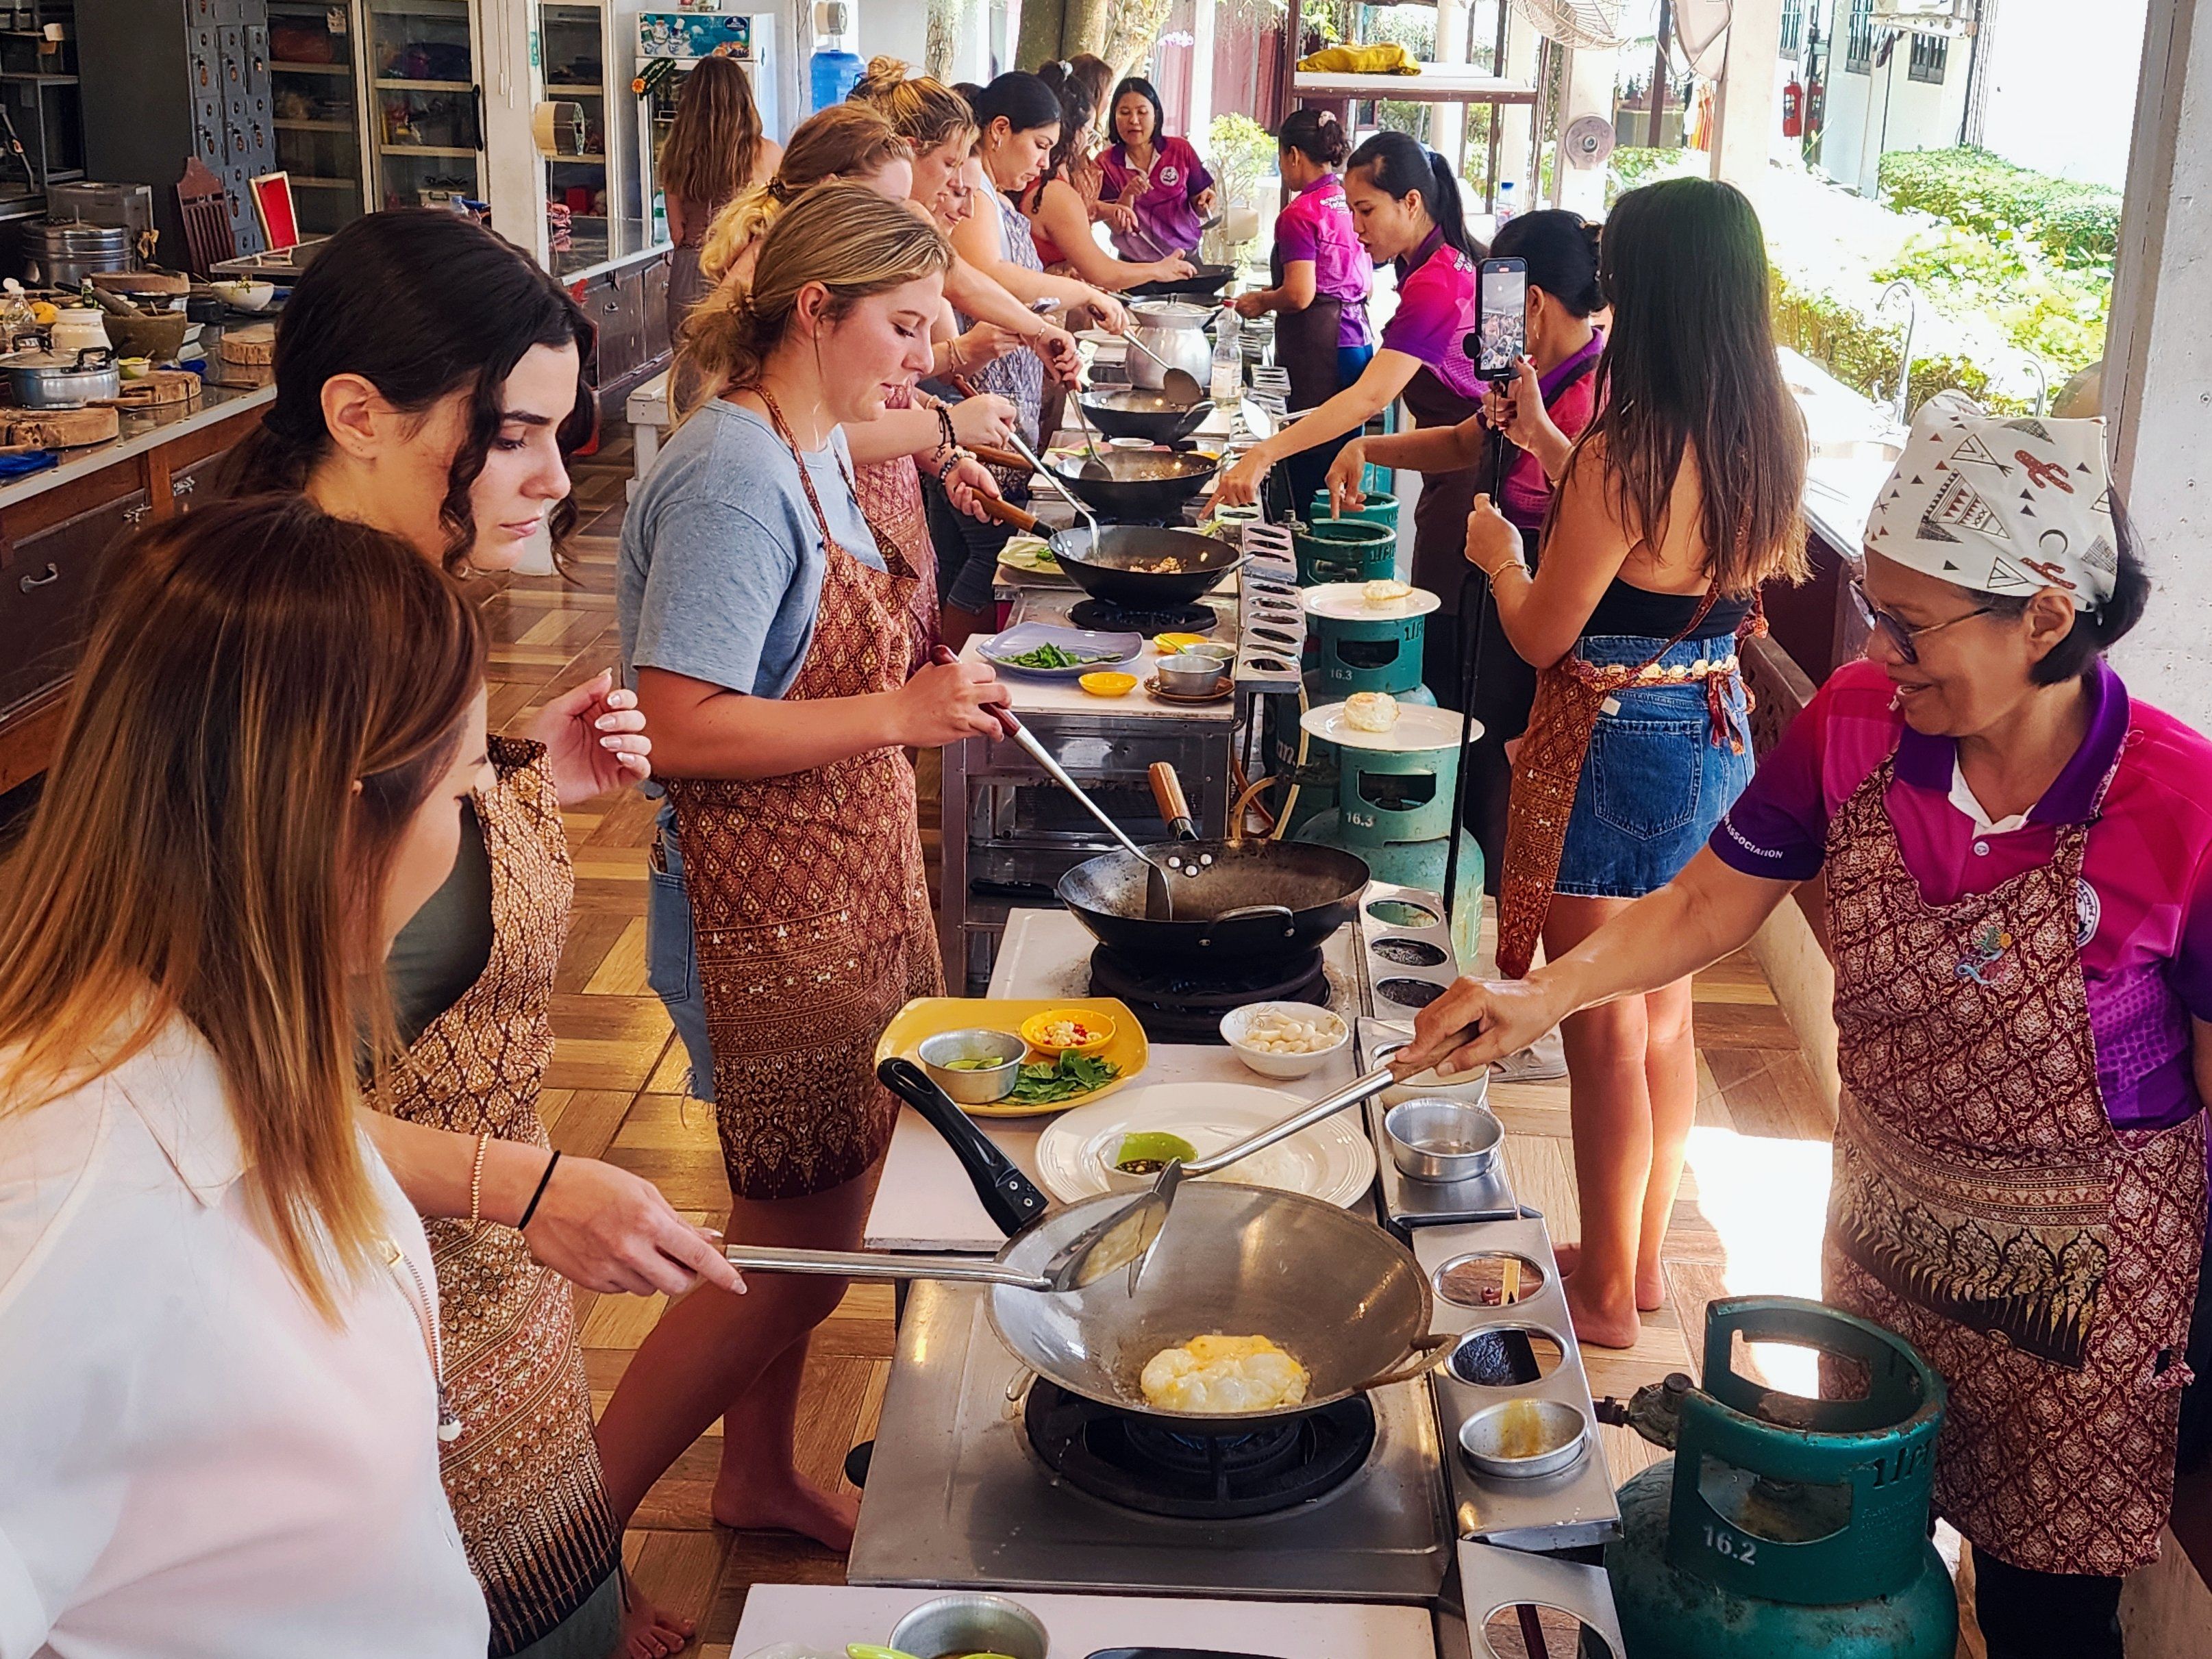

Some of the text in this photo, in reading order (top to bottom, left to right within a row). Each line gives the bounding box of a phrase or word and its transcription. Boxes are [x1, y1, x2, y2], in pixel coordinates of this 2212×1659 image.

[1331, 669, 1353, 681] 16.3
[1346, 812, 1375, 828] 16.3
[1726, 824, 1783, 858] ASSOCIATION
[1702, 1525, 1757, 1566] 16.2
